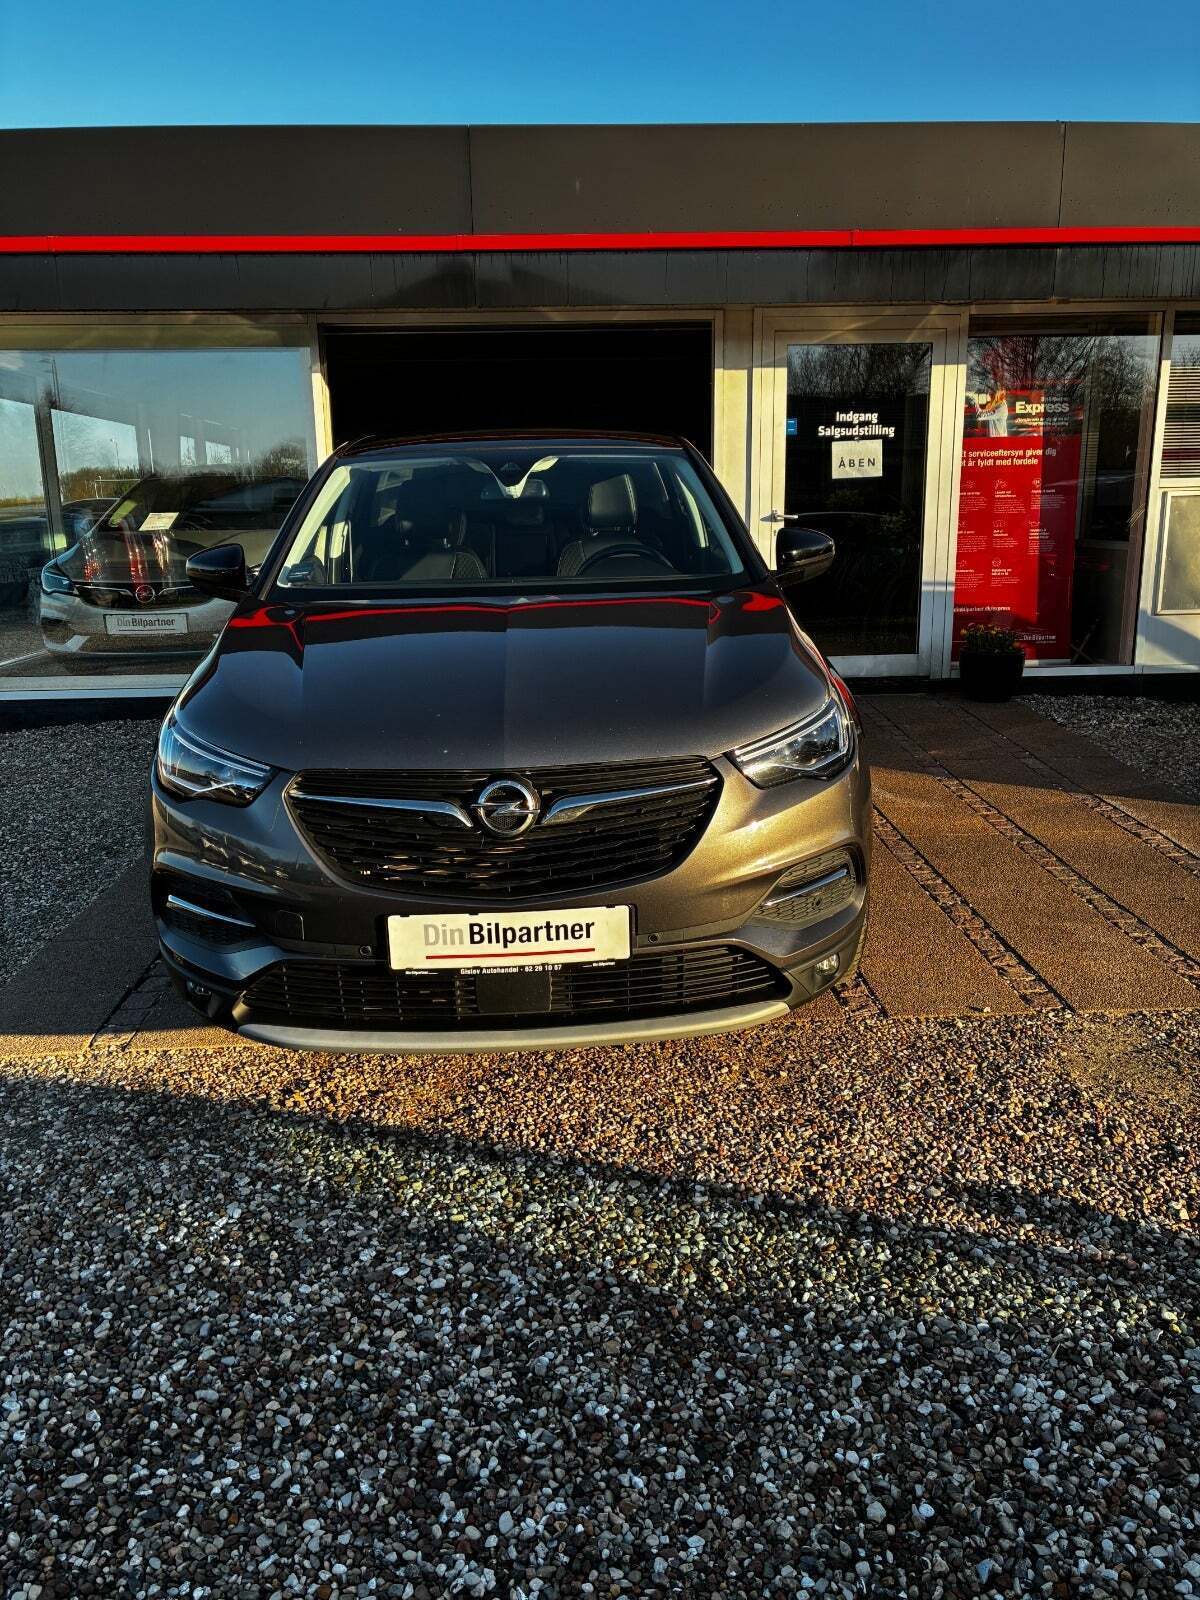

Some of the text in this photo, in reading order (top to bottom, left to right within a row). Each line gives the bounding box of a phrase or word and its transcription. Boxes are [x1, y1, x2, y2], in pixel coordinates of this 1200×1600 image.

[1015, 401, 1070, 415] Express
[836, 411, 878, 424] Indgang
[818, 425, 895, 438] Salgsudstilling
[968, 448, 1023, 459] serviceeftersyn
[1025, 447, 1043, 458] giver
[1045, 447, 1056, 456] dig
[838, 457, 876, 469] ÅBEN
[967, 458, 976, 467] år
[977, 458, 995, 468] fyldt
[995, 457, 1012, 466] med
[1013, 456, 1039, 465] fordele
[132, 617, 176, 628] Bilpartner
[423, 920, 596, 949] Din Bilpartner
[481, 966, 519, 975] Autohandel
